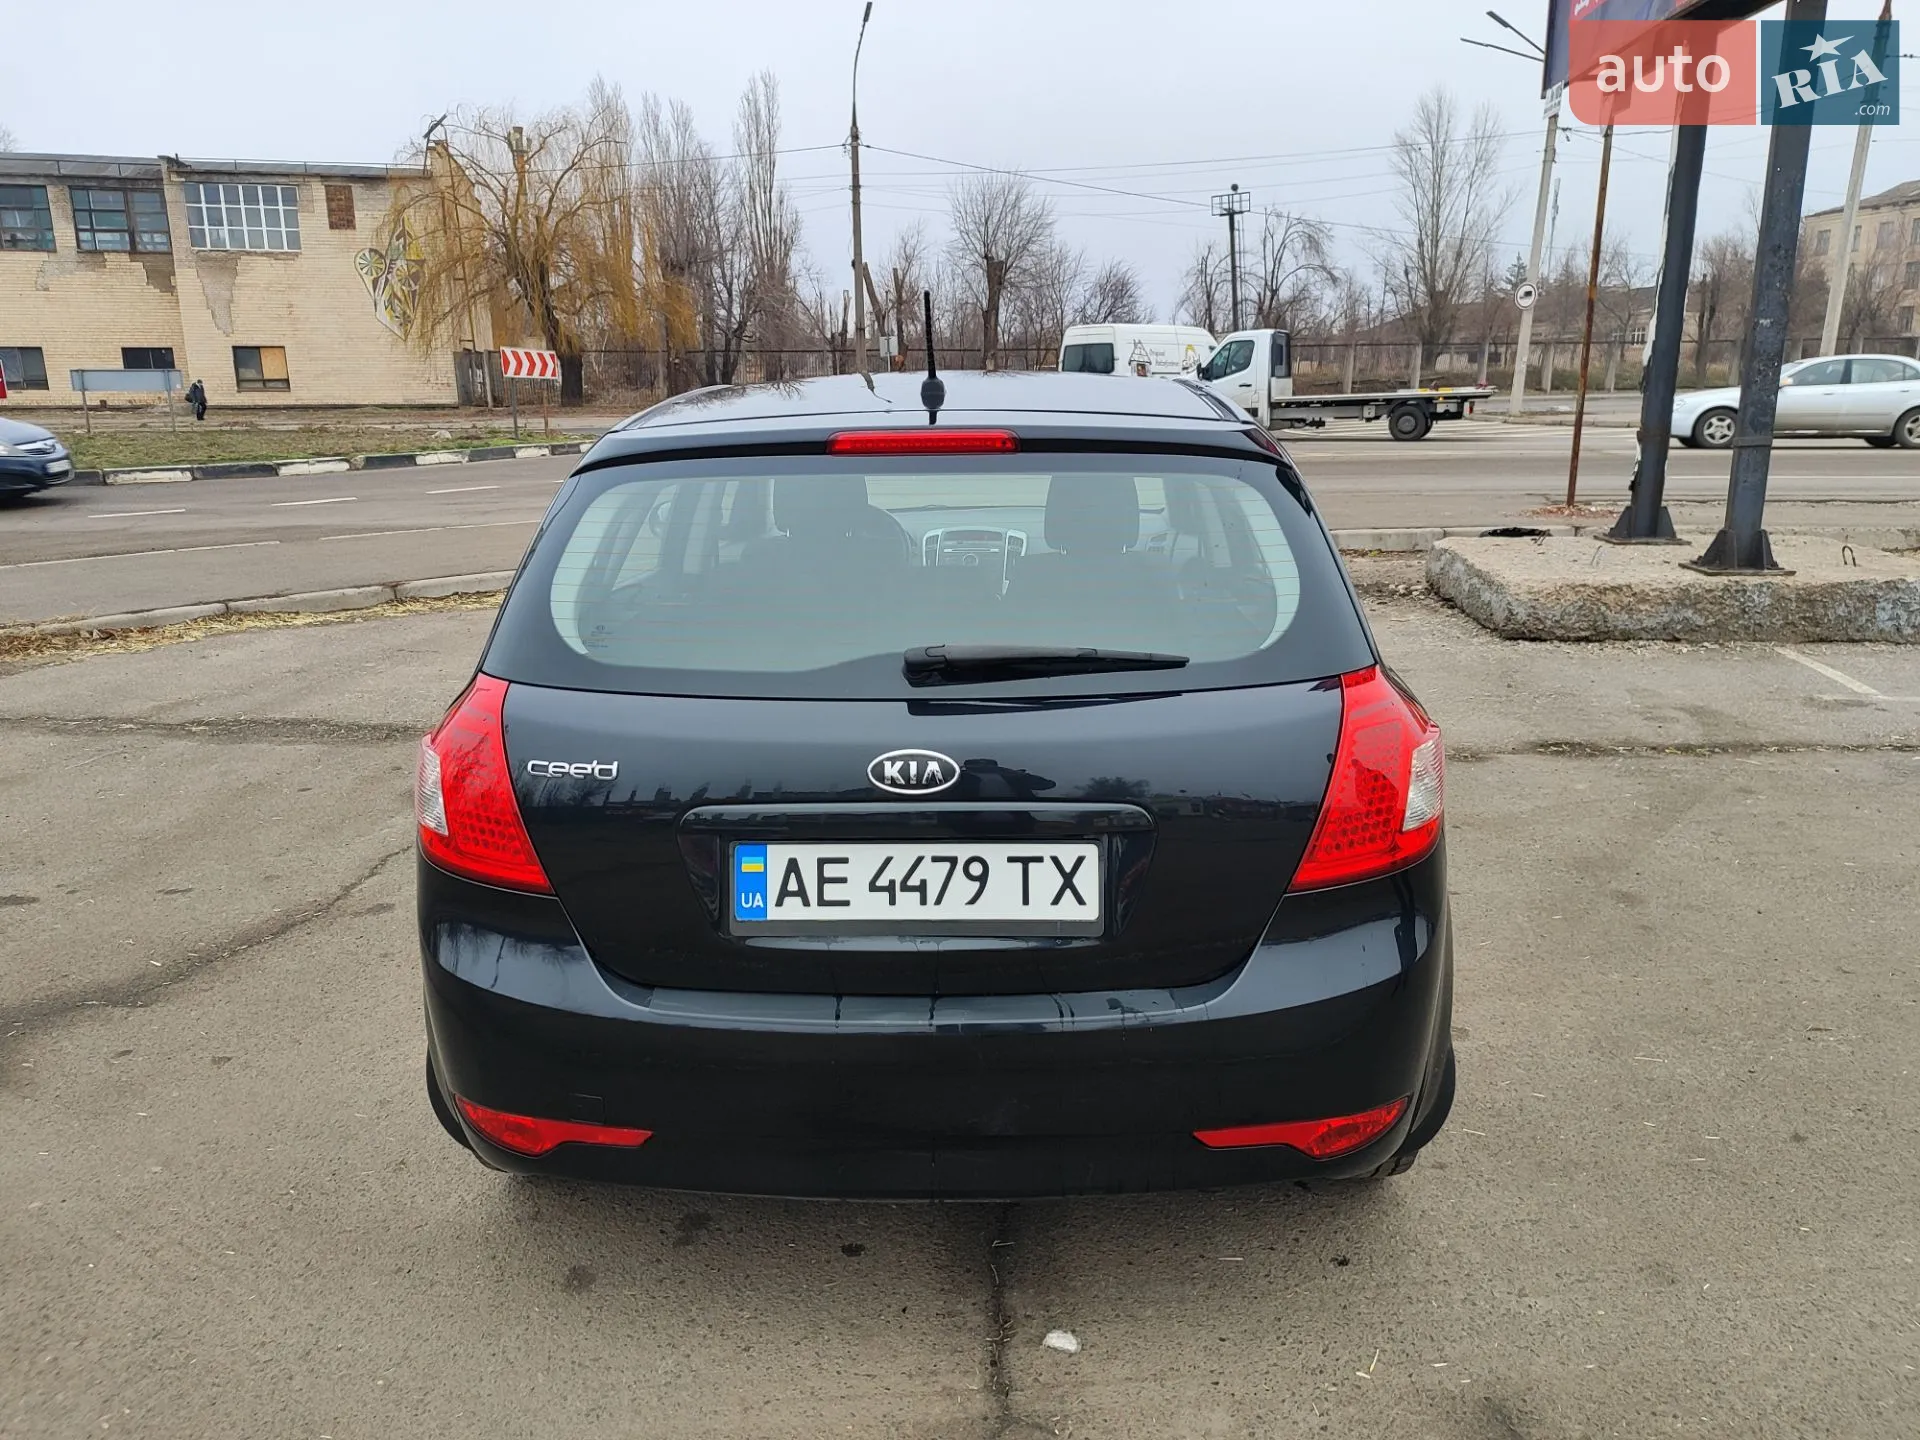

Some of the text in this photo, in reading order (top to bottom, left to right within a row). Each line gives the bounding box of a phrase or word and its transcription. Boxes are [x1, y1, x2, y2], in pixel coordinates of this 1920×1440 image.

[883, 760, 944, 785] KIA
[774, 855, 1087, 907] AE 4479 TX
[741, 892, 764, 908] UA
